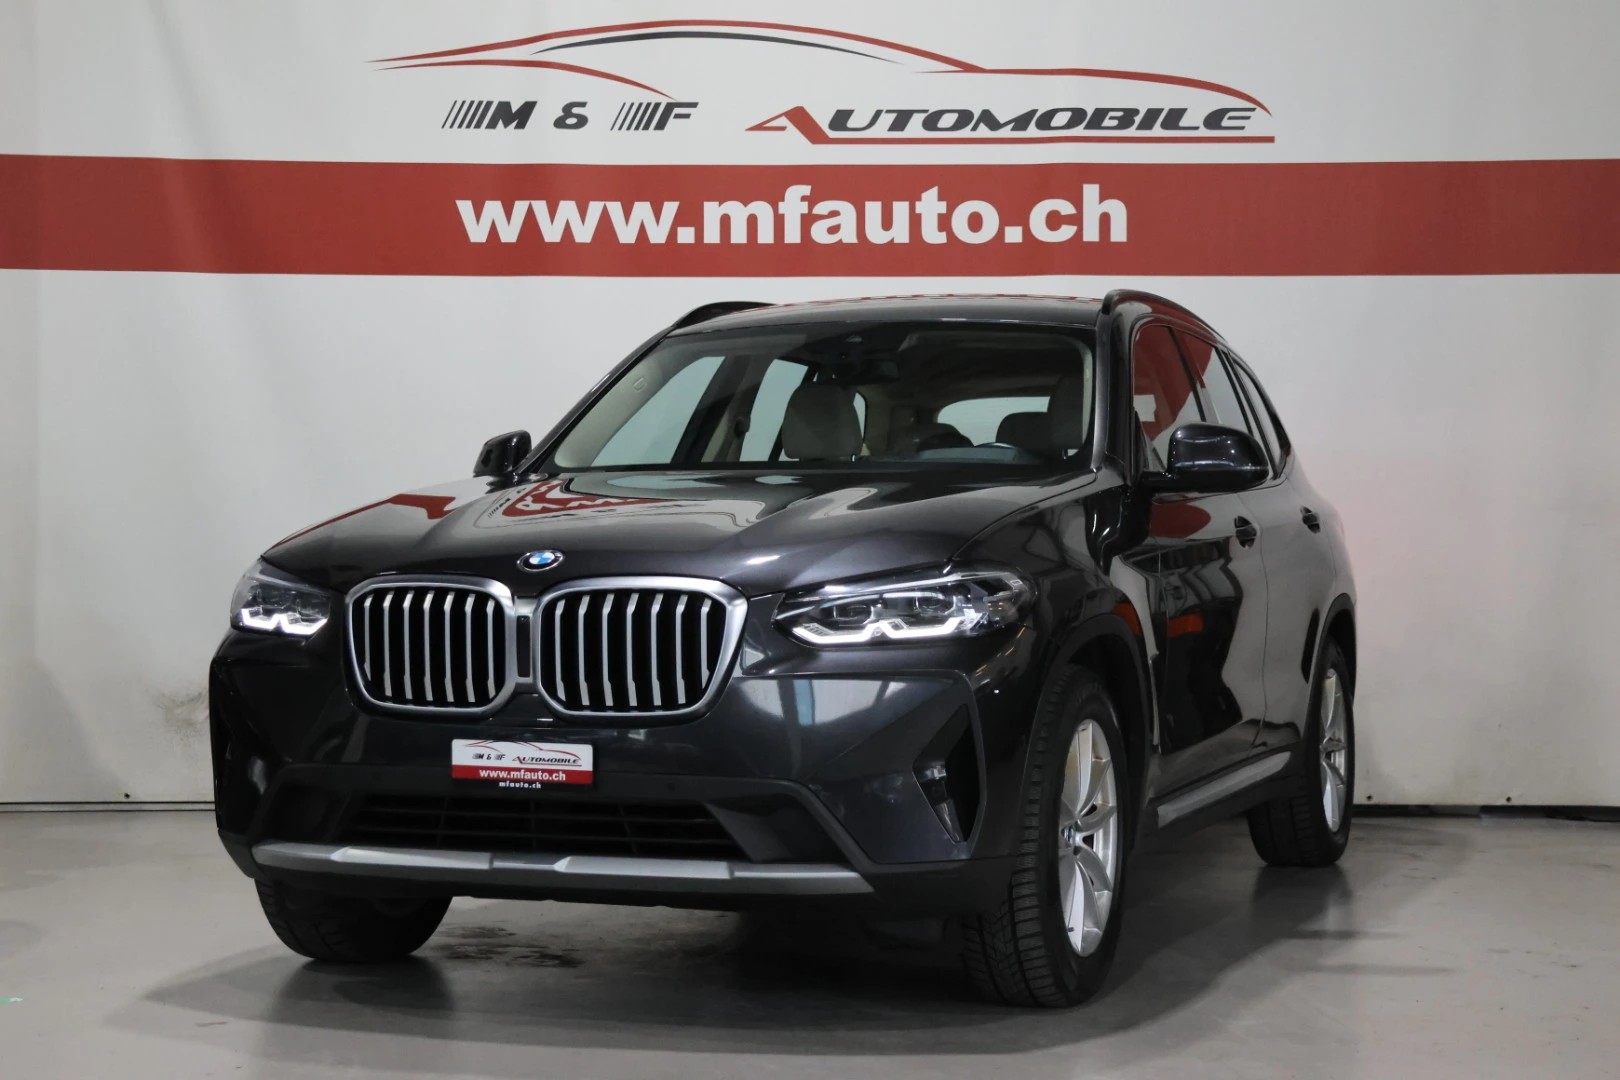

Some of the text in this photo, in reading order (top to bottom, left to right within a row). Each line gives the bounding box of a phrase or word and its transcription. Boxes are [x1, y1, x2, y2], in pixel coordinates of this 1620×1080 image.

[553, 101, 589, 130] &
[745, 105, 1258, 144] AUTOMOBILE
[456, 184, 1129, 245] www.mfauto.ch
[511, 756, 581, 765] AUTOMOBILE
[479, 769, 566, 781] www.mfauto.ch
[499, 781, 541, 789] mfauto.ch
